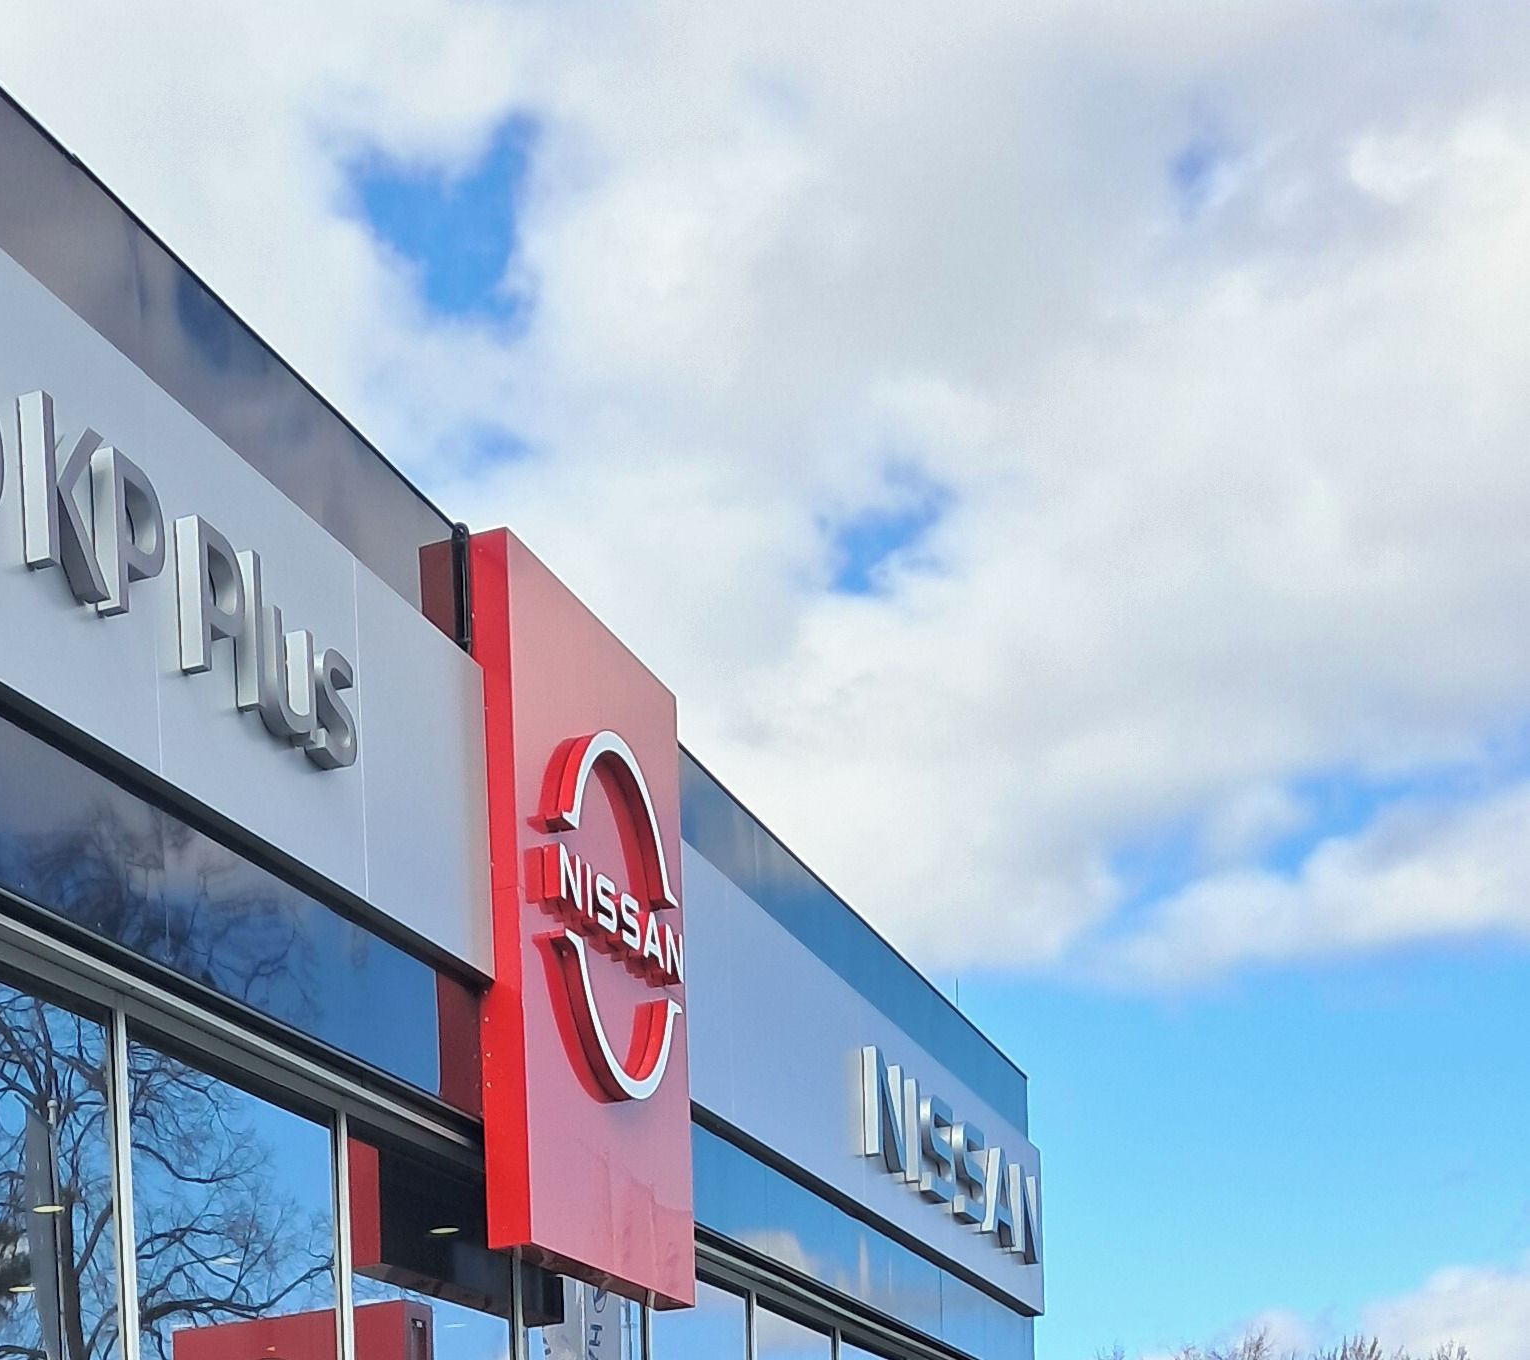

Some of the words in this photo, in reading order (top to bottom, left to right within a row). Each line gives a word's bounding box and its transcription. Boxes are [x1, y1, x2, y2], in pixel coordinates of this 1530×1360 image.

[17, 389, 166, 617] KP
[175, 514, 358, 770] Plus
[559, 842, 685, 984] NISSAN
[861, 1045, 1041, 1264] NISSAN
